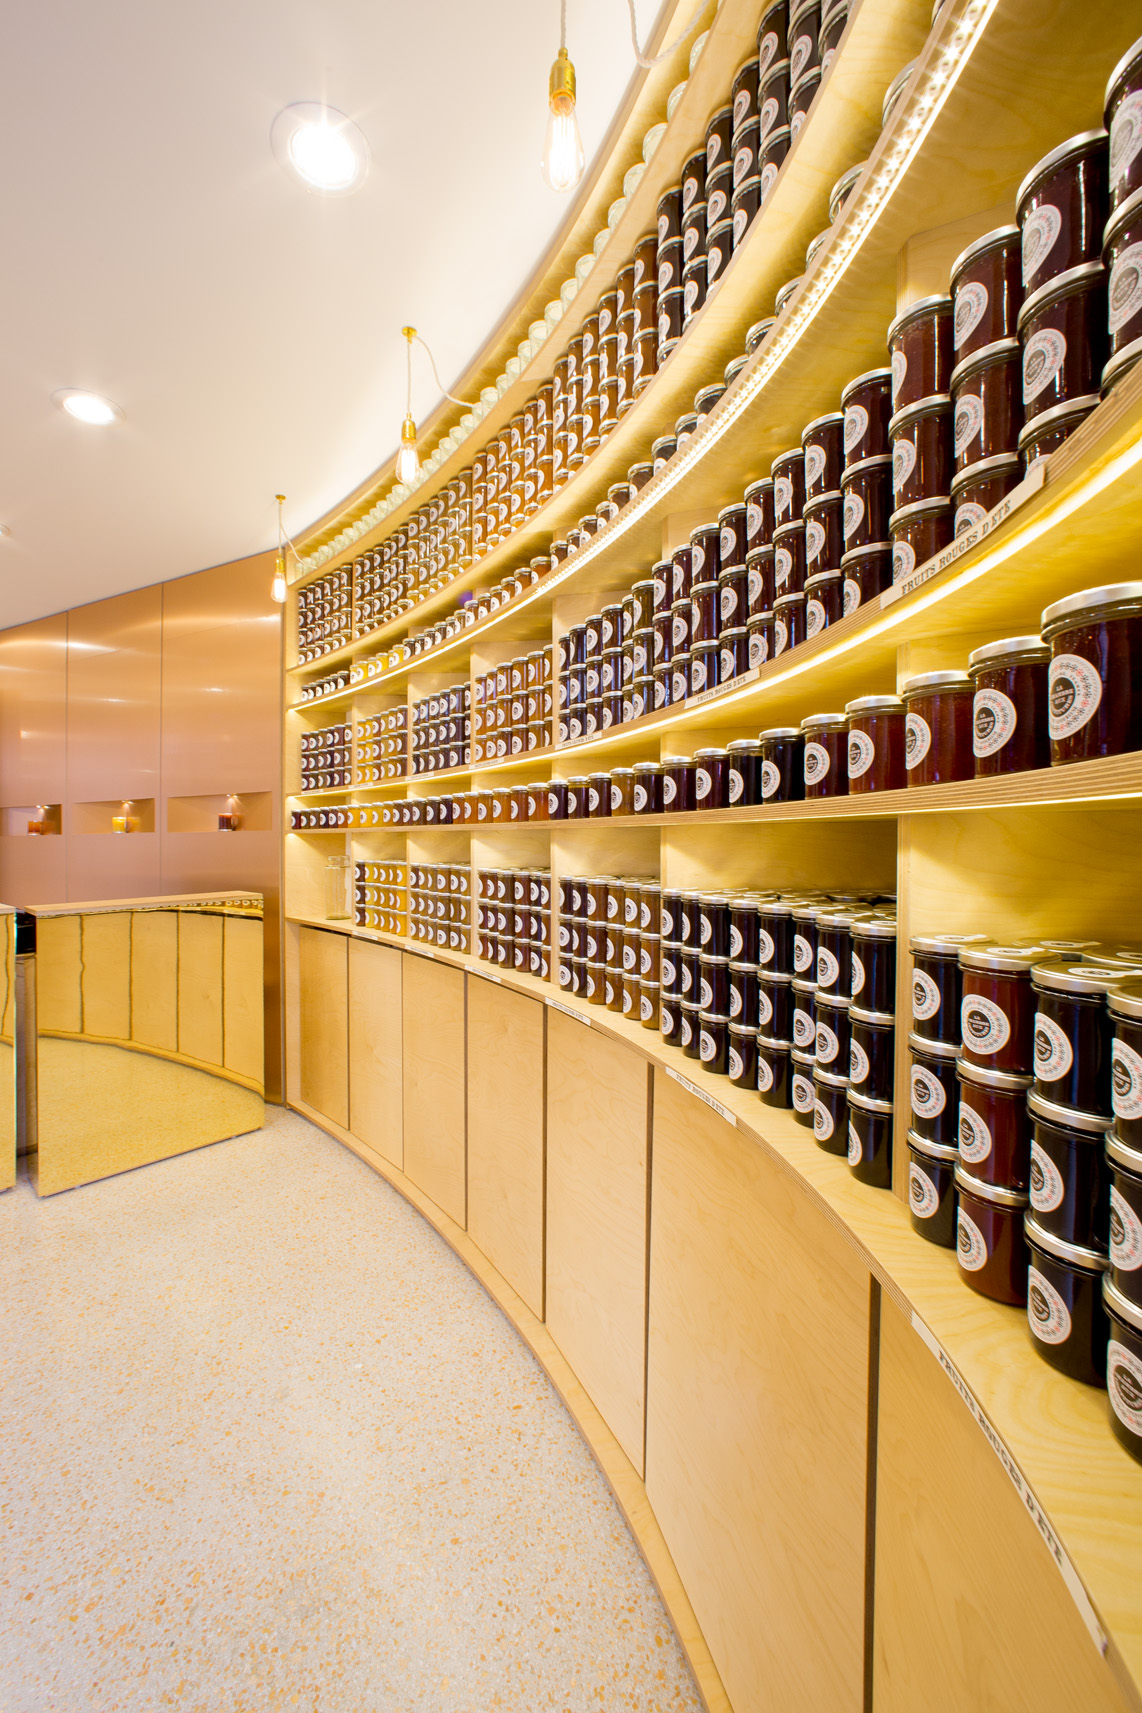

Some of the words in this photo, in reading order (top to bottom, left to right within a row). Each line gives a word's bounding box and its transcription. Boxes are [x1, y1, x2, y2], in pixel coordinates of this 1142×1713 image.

[901, 564, 936, 595] FRUITS
[939, 531, 978, 568] ROUGES
[939, 1350, 976, 1413] FRUITS
[977, 1413, 1023, 1491] ROUGES
